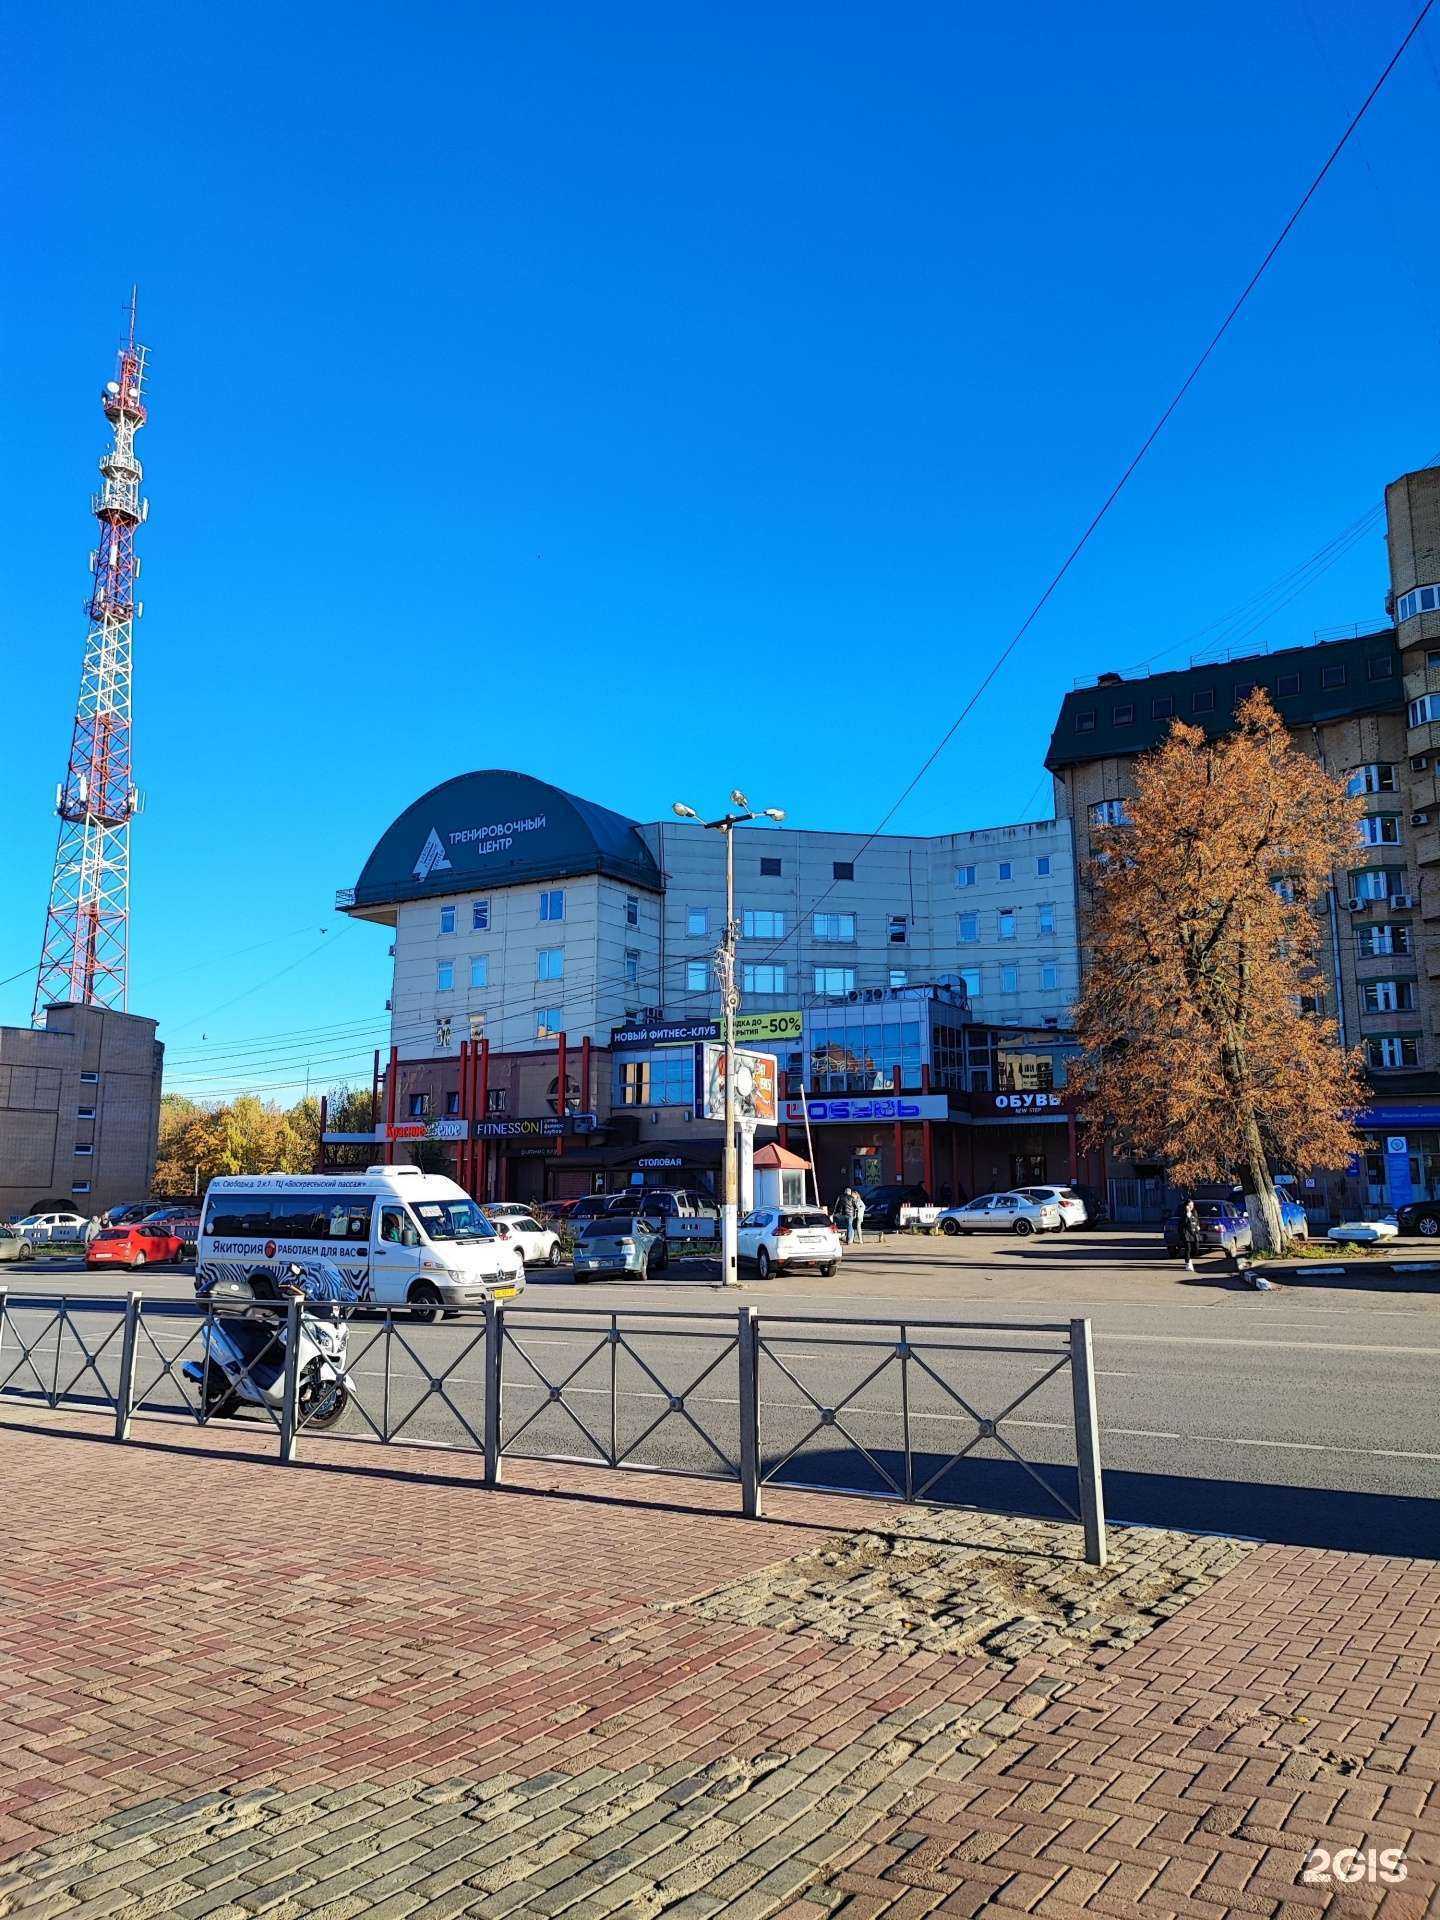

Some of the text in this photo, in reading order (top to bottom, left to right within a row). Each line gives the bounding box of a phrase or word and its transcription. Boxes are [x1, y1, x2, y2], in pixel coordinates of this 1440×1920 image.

[449, 814, 546, 844] ТРЕНИРОВОЧНЫЙ
[479, 838, 512, 855] ЦЕНТР
[614, 1025, 716, 1043] НОВЫЙ ФИТНЕС-КЛУБ
[995, 1093, 1062, 1108] ОБУВЬ
[638, 1158, 682, 1167] СТОЛОВАЯ
[278, 1245, 319, 1256] РАБОТАЕМ
[320, 1247, 338, 1258] ДЛЯ
[339, 1247, 357, 1258] ВАС
